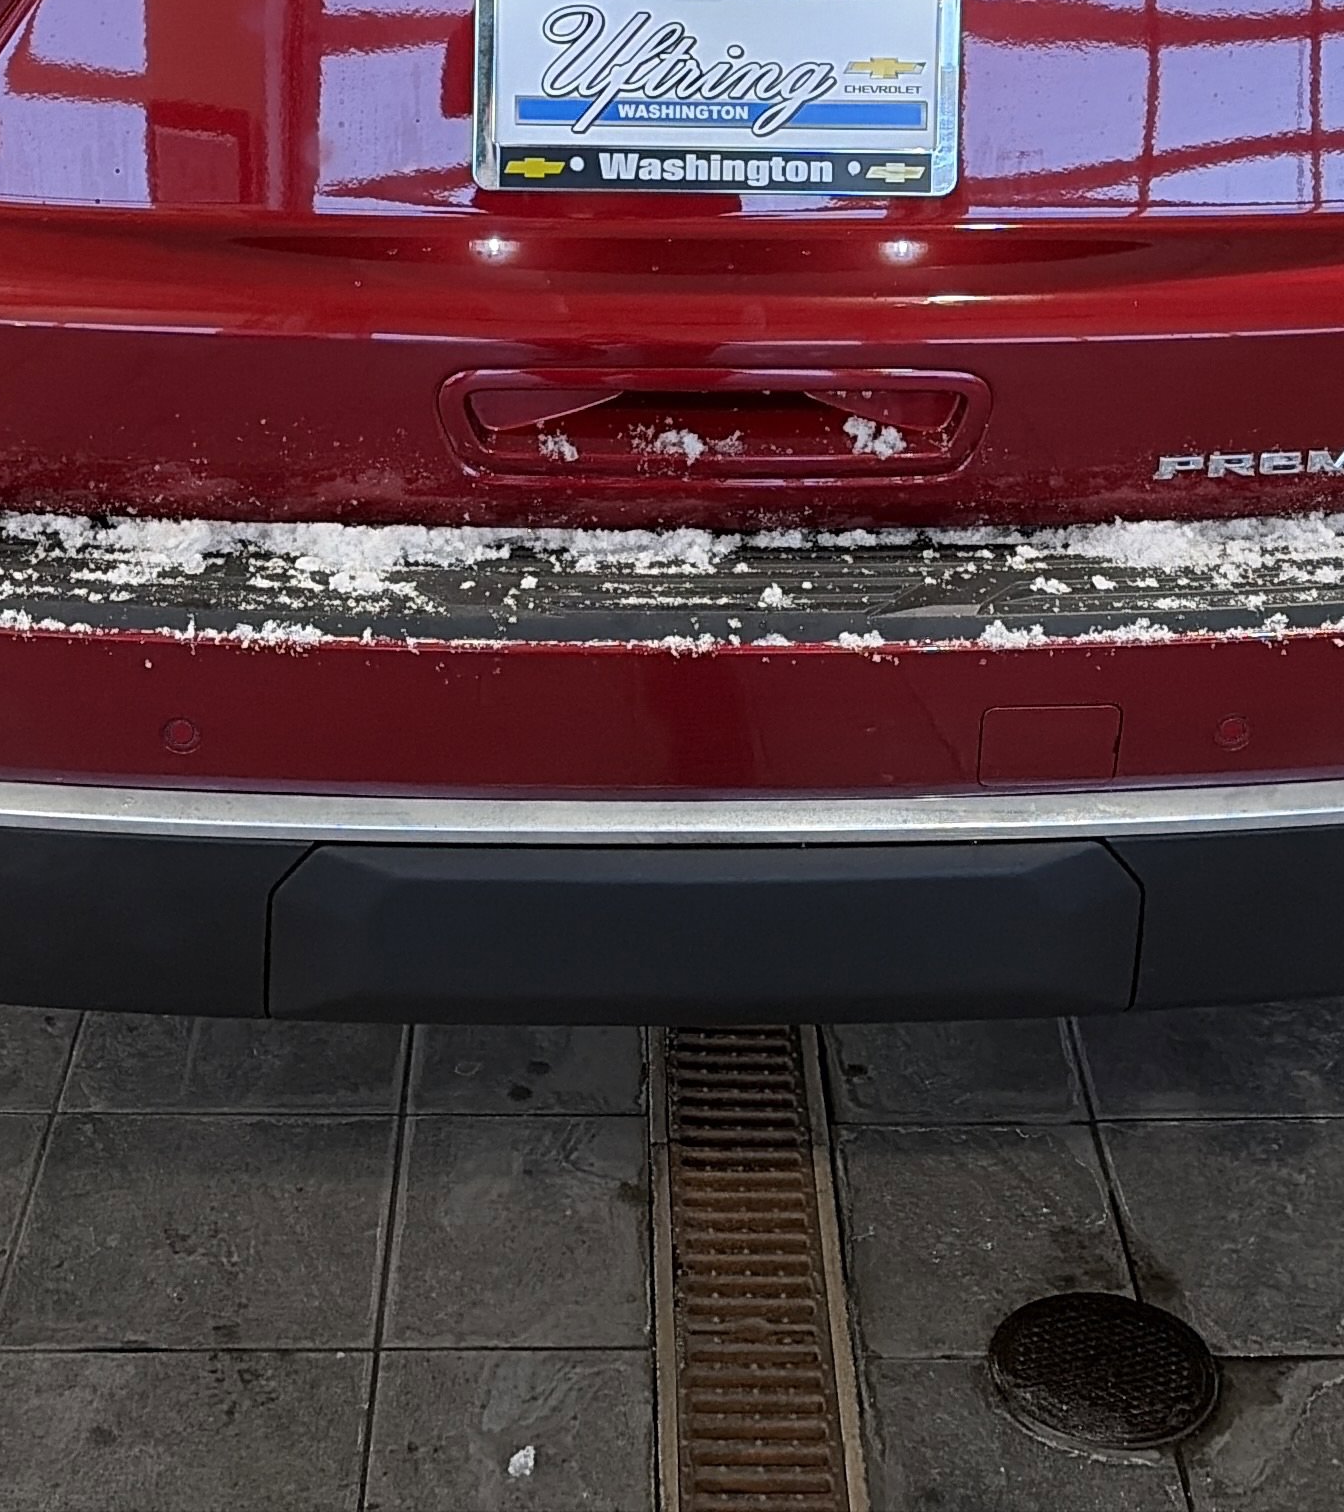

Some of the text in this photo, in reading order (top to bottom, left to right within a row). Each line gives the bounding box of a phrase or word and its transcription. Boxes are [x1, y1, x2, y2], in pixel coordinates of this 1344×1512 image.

[542, 4, 837, 137] Uftring
[843, 83, 923, 96] CHEVROLET
[617, 102, 750, 121] WASHINGTON
[598, 151, 834, 187] Washington
